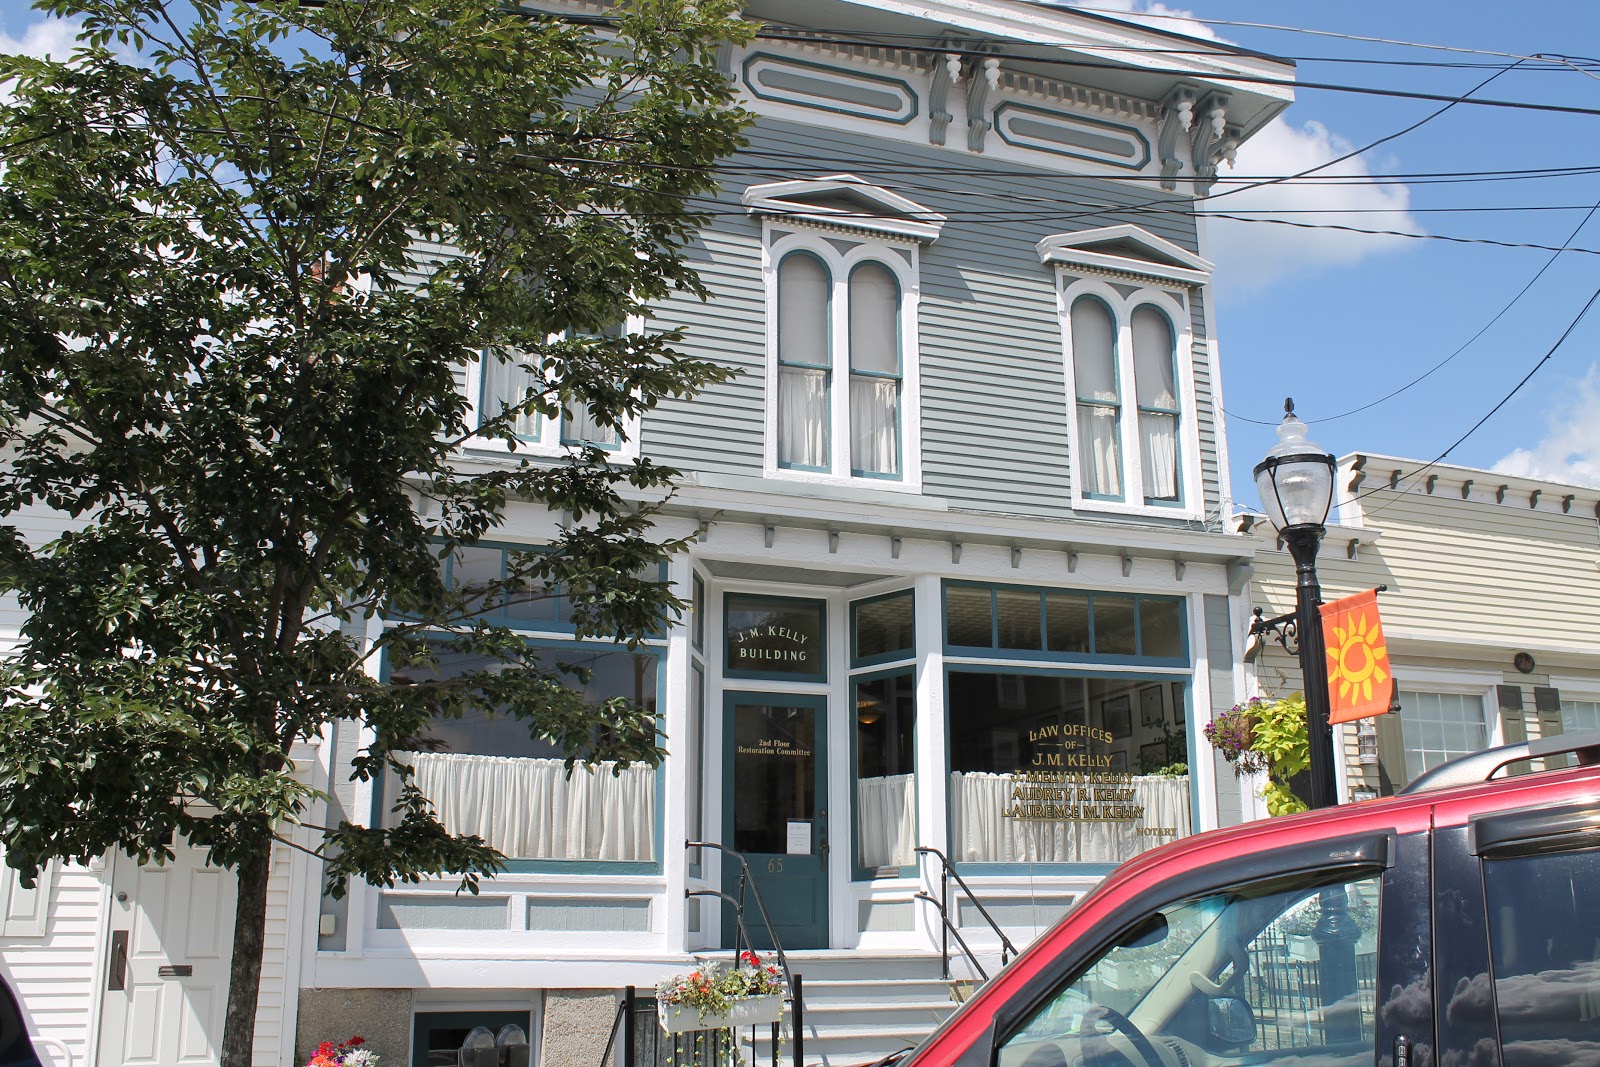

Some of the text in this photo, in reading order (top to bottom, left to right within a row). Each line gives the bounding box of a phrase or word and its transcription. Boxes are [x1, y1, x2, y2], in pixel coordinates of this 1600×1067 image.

[768, 625, 808, 644] KELLY
[740, 647, 807, 661] BUILDING
[1029, 723, 1114, 744] LAW OFFICES
[738, 745, 811, 756] Restoration Committee
[758, 739, 790, 748] 2nd Floor
[1064, 740, 1077, 750] OF
[1067, 753, 1114, 768] KELLY
[1025, 770, 1086, 784] MELVIN
[1089, 771, 1135, 785] KELLY
[1011, 786, 1073, 801] AUDREY
[1093, 788, 1137, 802] KELLY
[1001, 803, 1146, 819] LAURENCE M. KELLY
[1135, 827, 1178, 837] NOTARY
[767, 858, 783, 873] 65
